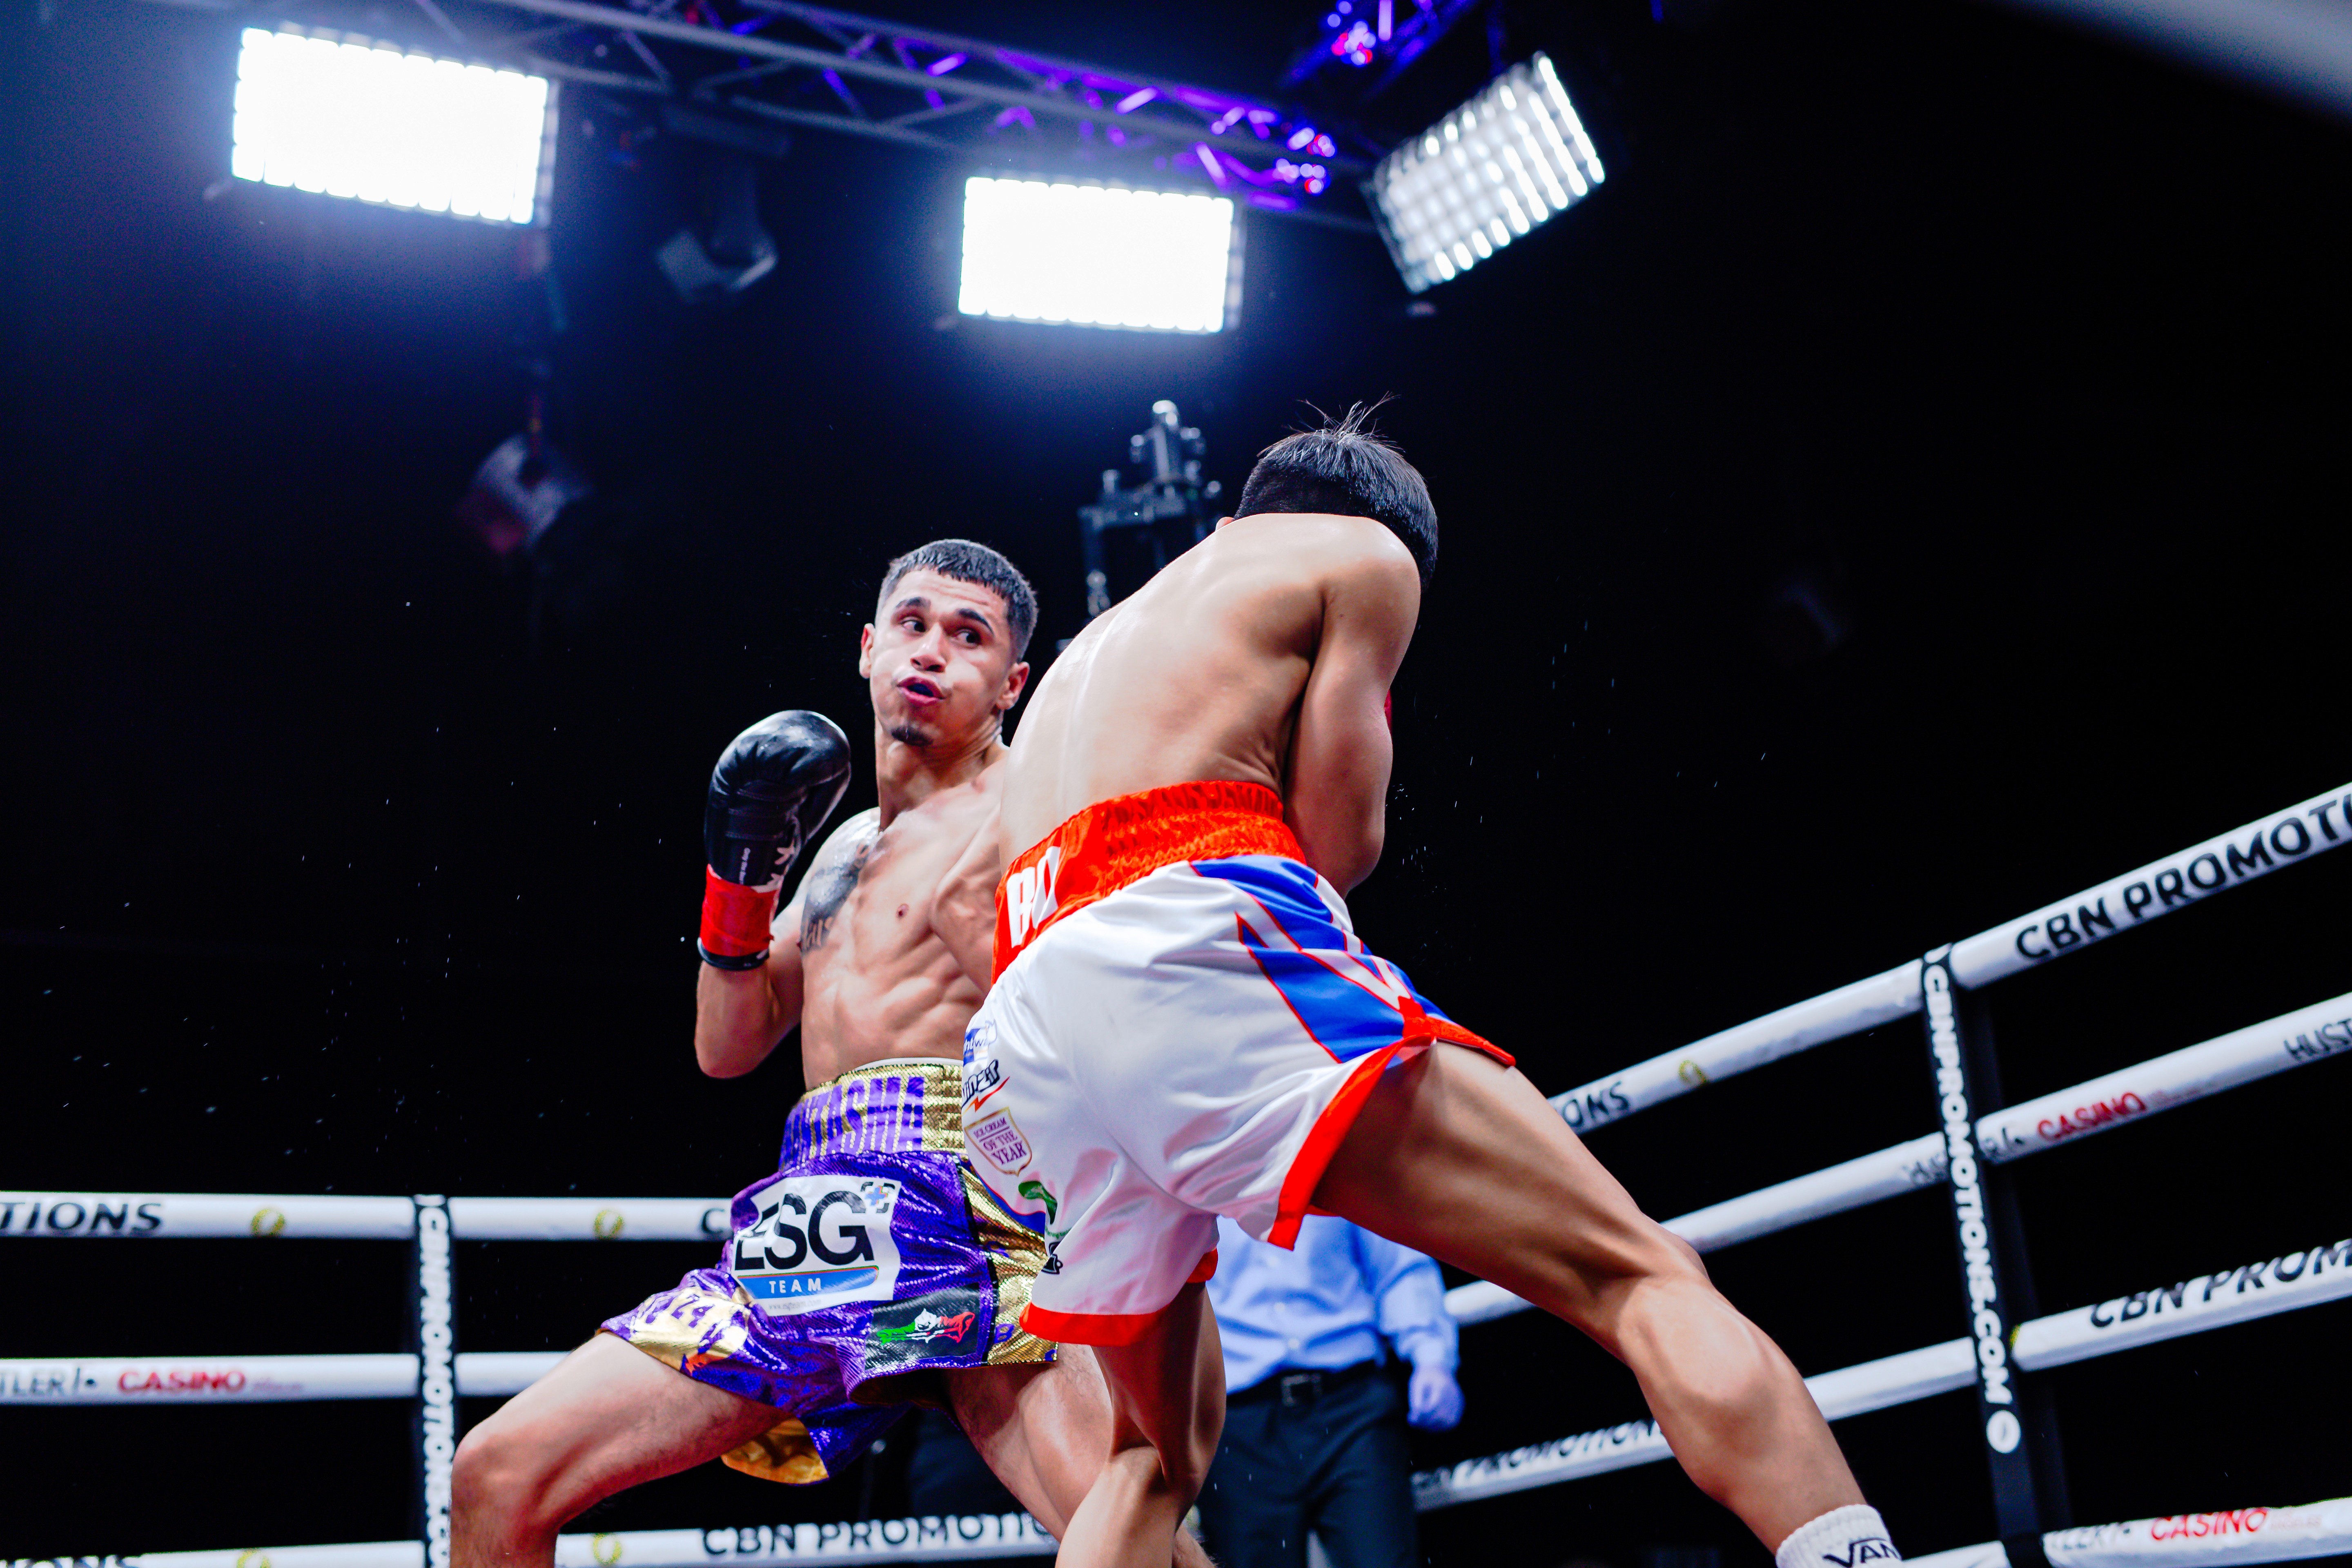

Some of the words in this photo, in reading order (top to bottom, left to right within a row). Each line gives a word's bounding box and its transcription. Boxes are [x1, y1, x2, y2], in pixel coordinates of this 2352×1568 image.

[2016, 897, 2115, 959] CBN
[2037, 1092, 2146, 1140] CASINO
[983, 1138, 998, 1152] OF
[996, 1129, 1018, 1146] THE
[991, 1140, 1027, 1165] YEAR
[735, 1190, 875, 1270] ESG
[769, 1278, 822, 1294] TEAM
[118, 1372, 246, 1394] CASINO
[703, 1524, 796, 1556] CBN
[2151, 1507, 2268, 1541] CASINO
